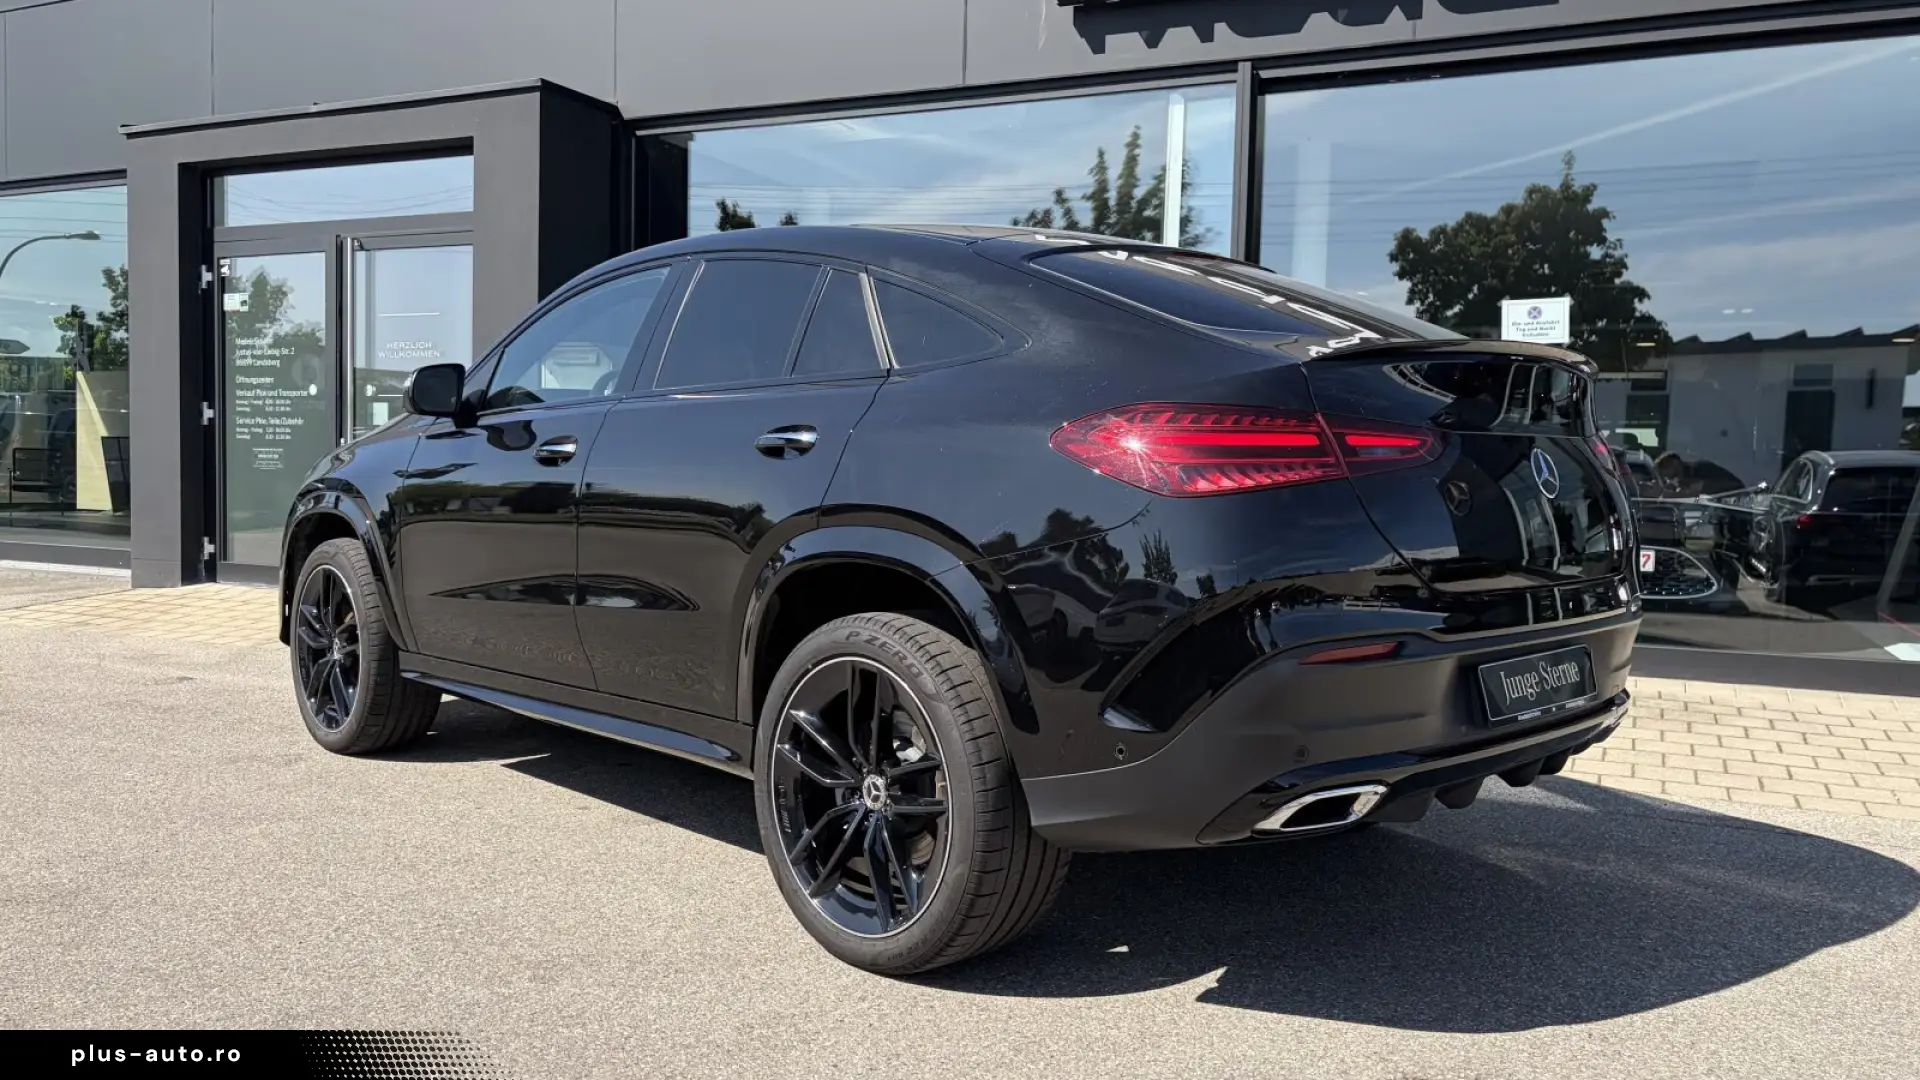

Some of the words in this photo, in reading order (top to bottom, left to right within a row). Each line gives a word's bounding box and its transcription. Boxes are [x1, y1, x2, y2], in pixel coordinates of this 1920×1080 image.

[386, 341, 432, 349] HERZLICH
[378, 350, 440, 359] WILLKOMMEN
[279, 388, 308, 397] Transporter
[1642, 553, 1651, 569] 7
[862, 634, 924, 679] ZERO
[1500, 671, 1540, 706] Junge
[1540, 661, 1580, 690] Sterne
